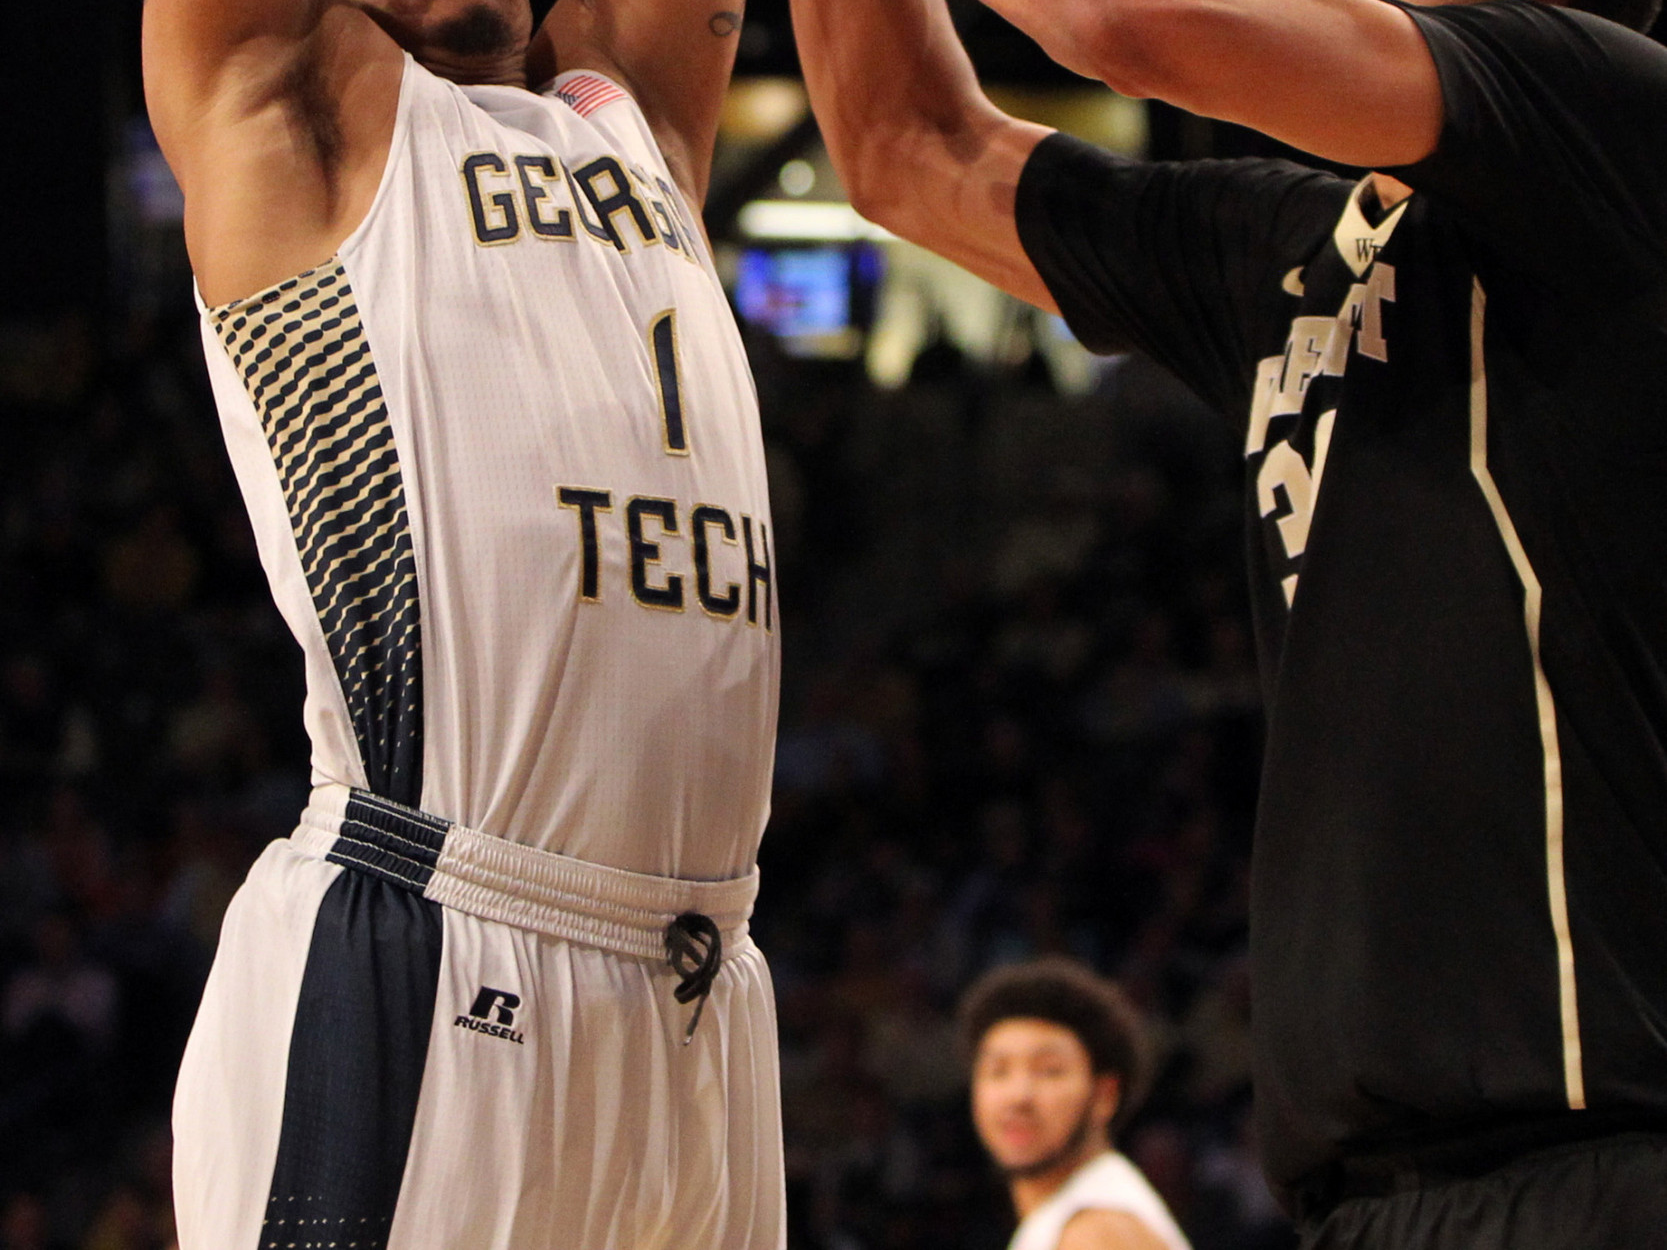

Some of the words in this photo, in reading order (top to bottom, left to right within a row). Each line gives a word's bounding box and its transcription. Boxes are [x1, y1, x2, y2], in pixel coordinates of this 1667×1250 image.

[648, 307, 691, 457] 1
[552, 484, 773, 637] TECH
[453, 1014, 525, 1045] RUSSELL
